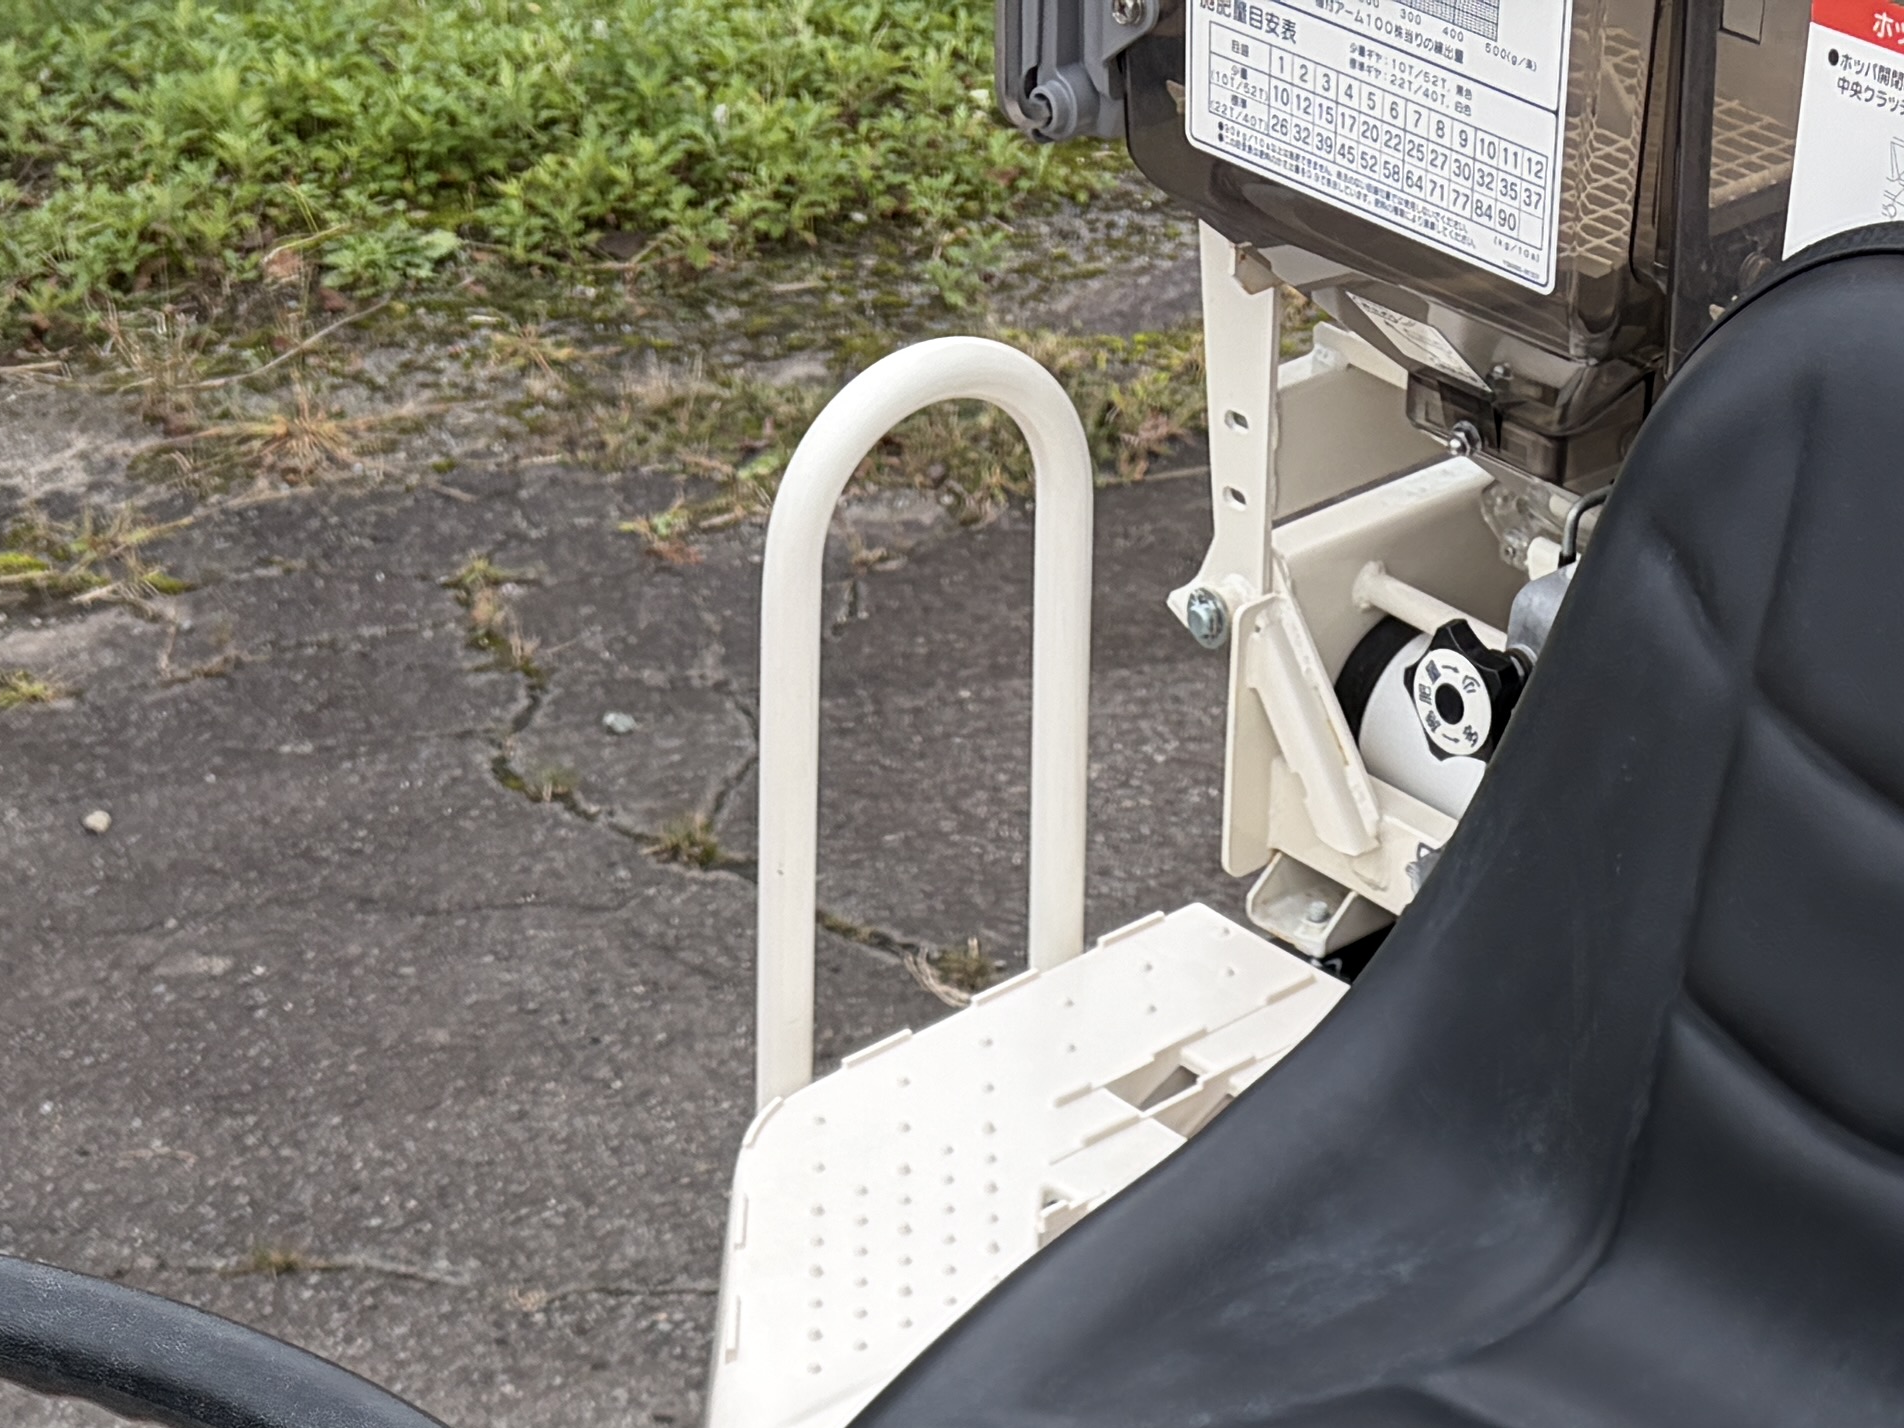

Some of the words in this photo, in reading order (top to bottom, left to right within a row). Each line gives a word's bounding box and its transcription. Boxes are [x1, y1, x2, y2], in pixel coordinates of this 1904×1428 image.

[1400, 8, 1422, 25] 300
[1442, 26, 1464, 42] 400
[1271, 113, 1287, 136] 26
[1293, 122, 1310, 146] 32
[1315, 131, 1332, 155] 39
[1337, 140, 1355, 165] 45
[1360, 150, 1377, 174] 52
[1382, 159, 1400, 183] 58
[1405, 169, 1423, 193] 64
[1428, 178, 1444, 202] 71
[1451, 188, 1469, 213] 77
[1474, 197, 1493, 222] 84
[1498, 207, 1516, 232] 90
[1273, 83, 1288, 106] 10
[1295, 92, 1311, 116] 12
[1318, 101, 1333, 125] 15
[1340, 110, 1356, 134] 17
[1361, 119, 1379, 143] 20
[1384, 128, 1401, 153] 22
[1406, 138, 1425, 163] 25
[1429, 147, 1447, 172] 27
[1452, 157, 1471, 182] 30
[1476, 167, 1494, 191] 32
[1499, 177, 1518, 201] 35
[1523, 186, 1541, 211] 37
[1278, 54, 1284, 73] 1
[1299, 62, 1308, 83] 2
[1321, 71, 1330, 92] 3
[1344, 80, 1353, 101] 4
[1367, 90, 1376, 111] 5
[1389, 99, 1399, 121] 6
[1413, 109, 1422, 130] 7
[1435, 118, 1445, 140] 8
[1458, 127, 1468, 149] 9
[1479, 136, 1496, 161] 10
[1502, 146, 1517, 169] 11
[1526, 155, 1544, 180] 12
